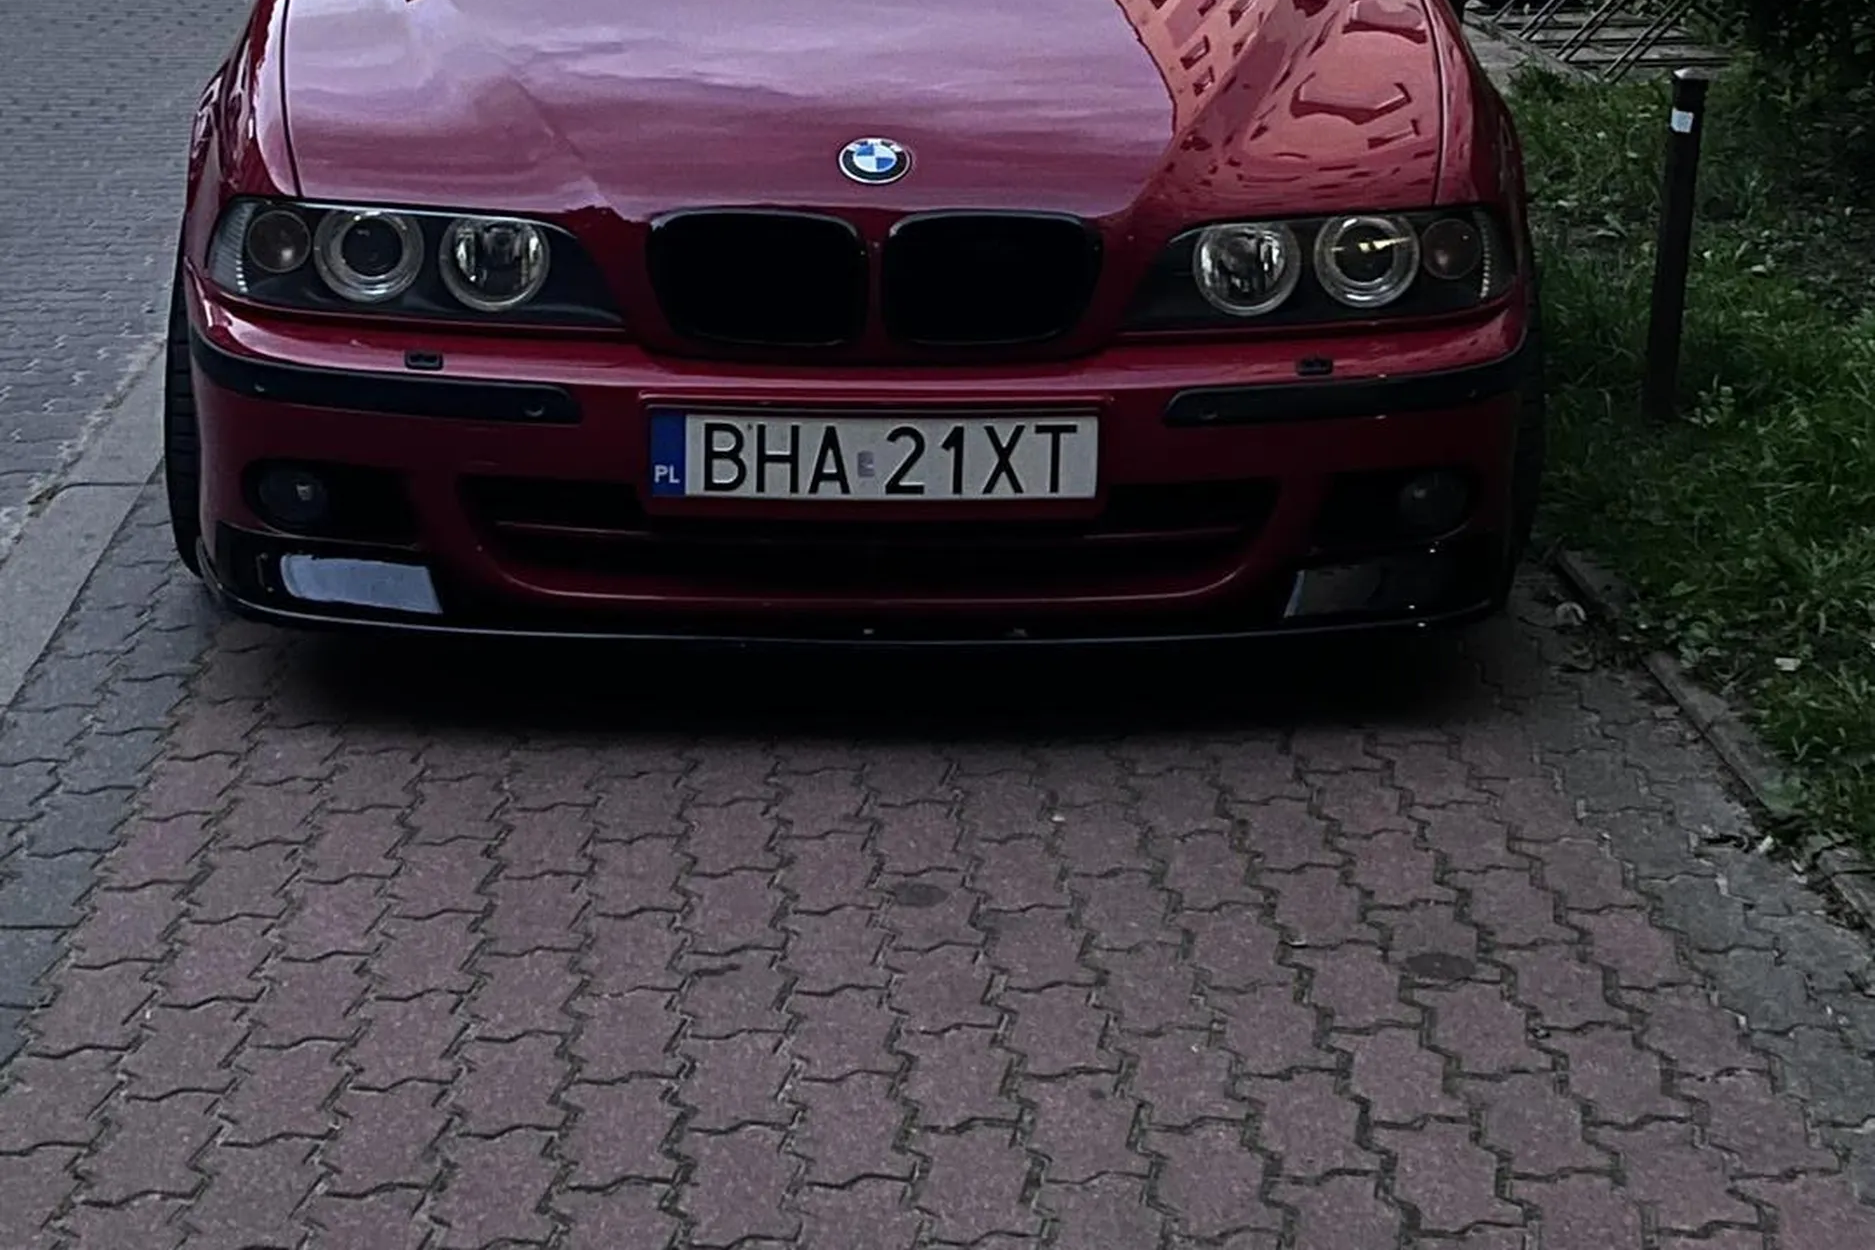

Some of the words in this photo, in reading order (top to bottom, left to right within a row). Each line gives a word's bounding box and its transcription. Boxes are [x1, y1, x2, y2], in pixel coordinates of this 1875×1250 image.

[654, 464, 680, 483] PL
[704, 423, 850, 494] BHA
[885, 424, 1078, 495] 21XT
